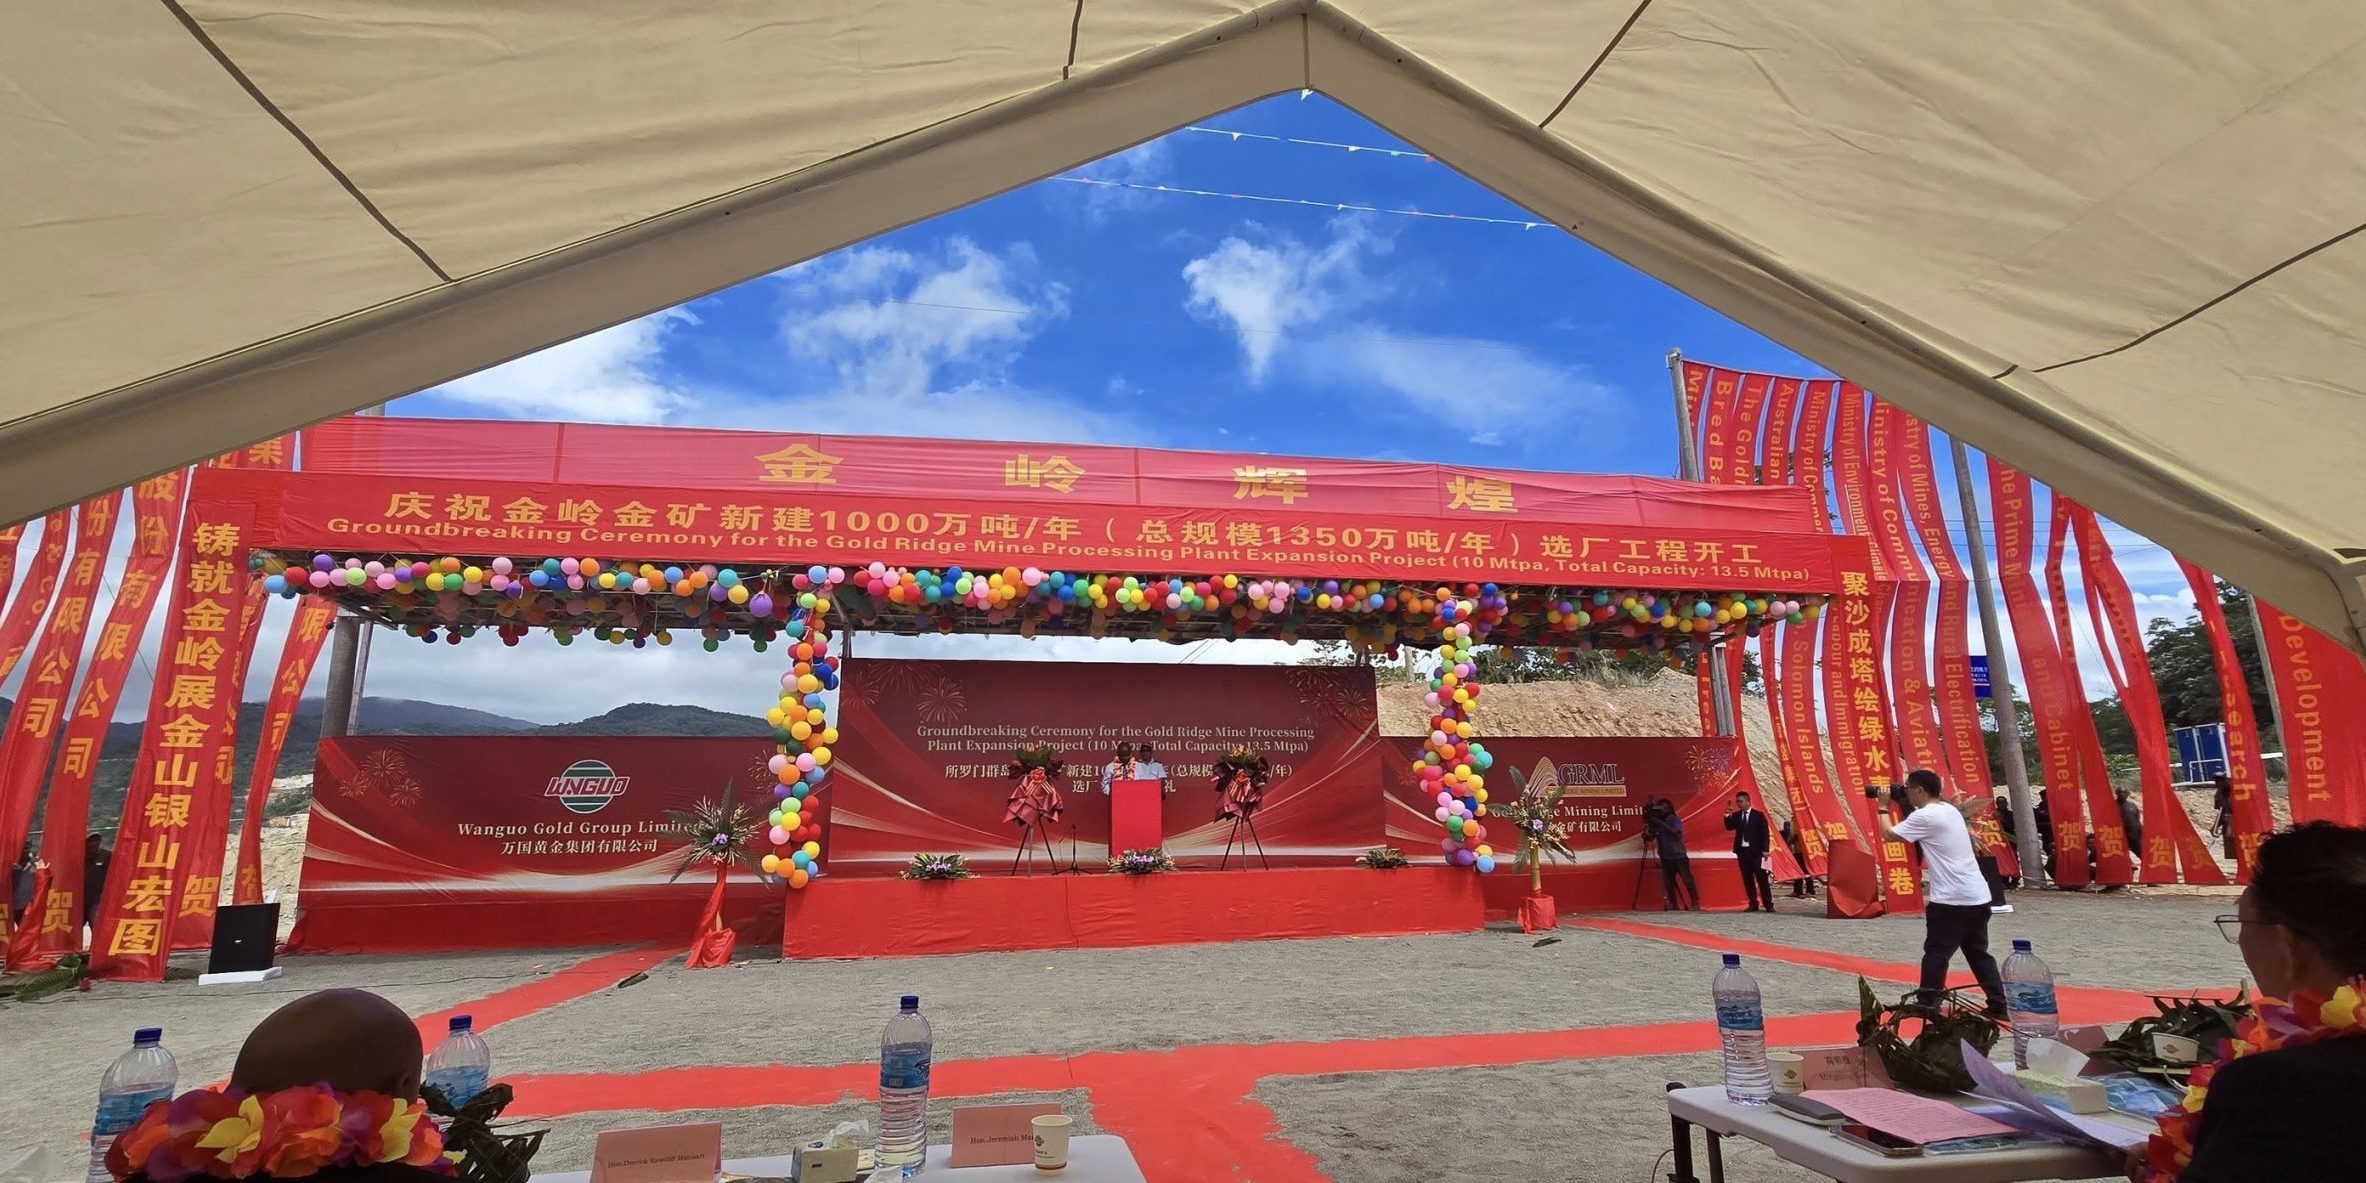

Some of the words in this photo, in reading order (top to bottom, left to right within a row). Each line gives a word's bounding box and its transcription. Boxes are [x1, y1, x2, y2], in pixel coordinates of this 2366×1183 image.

[1709, 380, 1734, 446] Bred
[1741, 385, 1764, 422] The
[1804, 391, 1826, 457] Ministry
[1839, 394, 1861, 448] Ministry
[1770, 383, 1794, 479] Australian
[1873, 402, 1889, 480] inistry
[1903, 413, 1918, 449] stry
[1803, 457, 1818, 472] of
[1908, 455, 1924, 469] of
[1999, 460, 2017, 494] he
[1878, 485, 1895, 504] of
[1911, 473, 1932, 524] Mines,
[327, 517, 572, 543] Groundbreaking
[580, 527, 723, 549] Ceremony
[730, 532, 769, 548] for
[776, 535, 819, 549] the
[826, 535, 888, 551] Gold
[895, 537, 967, 554] Ridge
[974, 539, 1036, 555] Mine
[1042, 542, 1173, 561] Processing
[1180, 547, 1241, 562] Plant
[1247, 550, 1364, 566] Expansion
[1370, 552, 1447, 569] Project
[1453, 556, 1484, 570] (10
[1490, 558, 1550, 574] Mtpa,
[1555, 559, 1608, 574] Total
[1612, 561, 1705, 579] Capacity:
[1710, 564, 1750, 579] 13.5
[1754, 566, 1811, 583] Mtpa)
[2004, 499, 2023, 562] Prime
[1925, 528, 1955, 578] Energy
[1792, 641, 1809, 724] Solomon
[1831, 670, 1846, 699] and
[1903, 679, 1921, 693] &
[1944, 662, 1980, 784] Electrification
[2279, 614, 2333, 803] Development
[107, 522, 241, 956] 铸就金岭展金山银山宏图
[917, 725, 1027, 738] Groundbreaking
[1030, 725, 1096, 739] Ceremony
[1099, 725, 1118, 737] for
[1121, 726, 1142, 737] the
[1144, 726, 1174, 737] Gold
[1178, 726, 1213, 739] Ridge
[1215, 727, 1246, 737] Mine
[1250, 727, 1315, 740] Processing
[928, 740, 962, 751] Plant
[966, 740, 1034, 753] Expansion
[1038, 740, 1084, 753] Project
[1088, 741, 1108, 752] (10
[1152, 740, 1181, 751] Total
[1274, 741, 1309, 754] Mtpa)
[1834, 701, 1866, 796] Immigration
[1840, 571, 1915, 897] 聚沙成塔绘绿水青画卷
[2044, 703, 2074, 791] Cabinet
[1558, 763, 1625, 784] GRML
[1797, 728, 1824, 795] Islands
[458, 822, 527, 838] Wanguo
[533, 821, 573, 835] Gold
[580, 821, 632, 837] Group
[1564, 805, 1608, 818] Mining
[1612, 804, 1643, 816] Limit
[500, 837, 658, 855] 万国黄金集团有限公司
[1801, 828, 1825, 860] 贺
[2059, 821, 2082, 852] 贺
[2099, 825, 2125, 858] 贺
[2149, 835, 2173, 868] 贺
[42, 889, 73, 934] 贺
[179, 875, 219, 918] 贺
